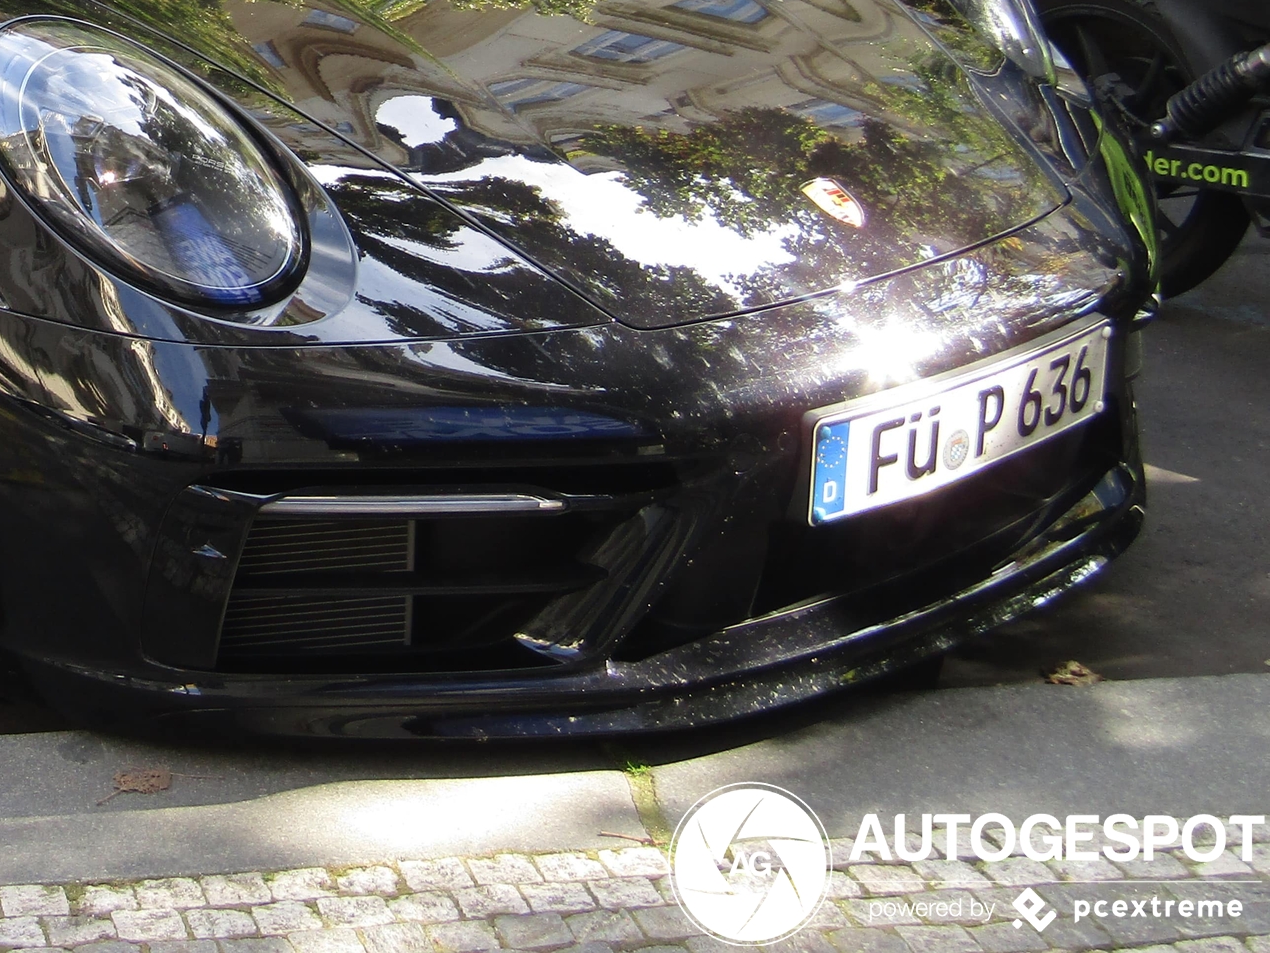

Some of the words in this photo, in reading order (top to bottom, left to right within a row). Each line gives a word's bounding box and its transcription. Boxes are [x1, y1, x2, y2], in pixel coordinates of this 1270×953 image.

[822, 479, 838, 504] D
[865, 405, 941, 497] FÜ
[973, 384, 1005, 459] P
[1017, 346, 1091, 437] 636
